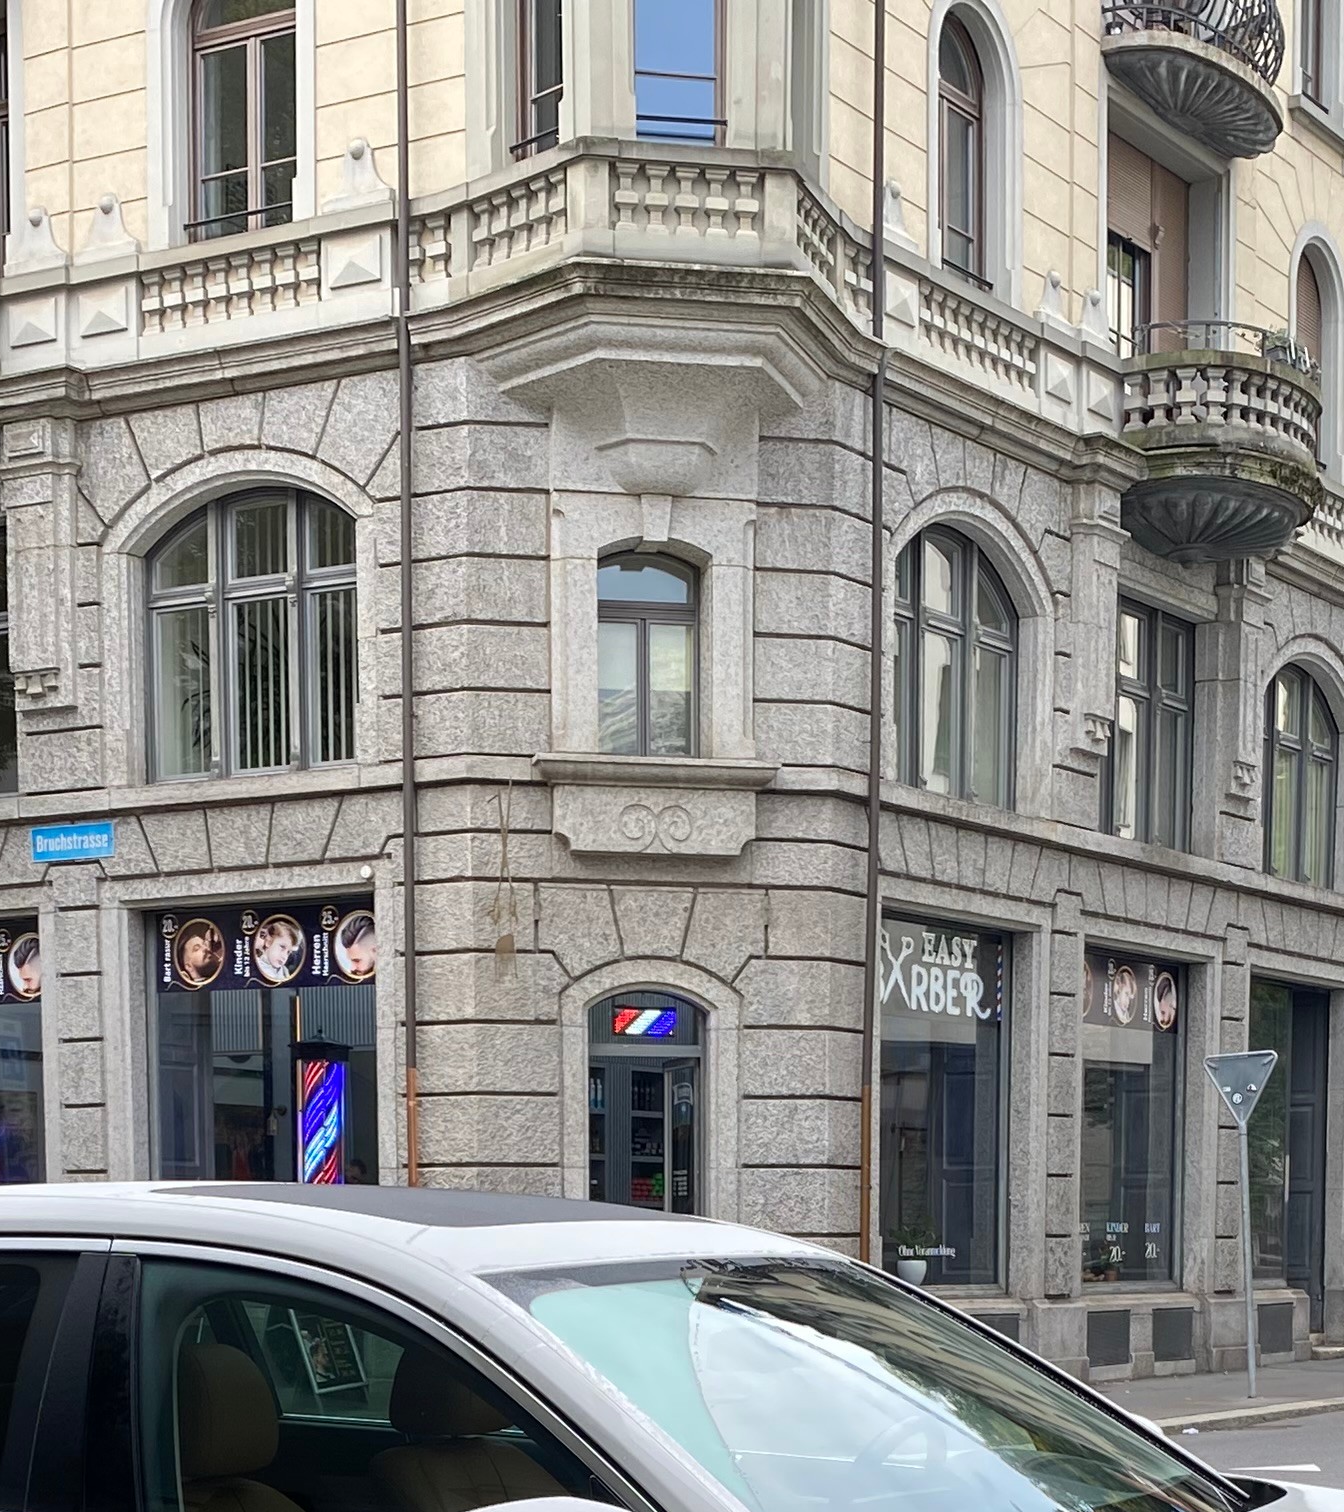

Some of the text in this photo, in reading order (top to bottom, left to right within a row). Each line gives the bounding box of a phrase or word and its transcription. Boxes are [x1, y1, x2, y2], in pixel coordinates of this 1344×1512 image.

[36, 833, 109, 853] Bruchstrasse
[234, 938, 243, 975] Kinder
[311, 934, 321, 975] Herren
[921, 931, 978, 970] EASY
